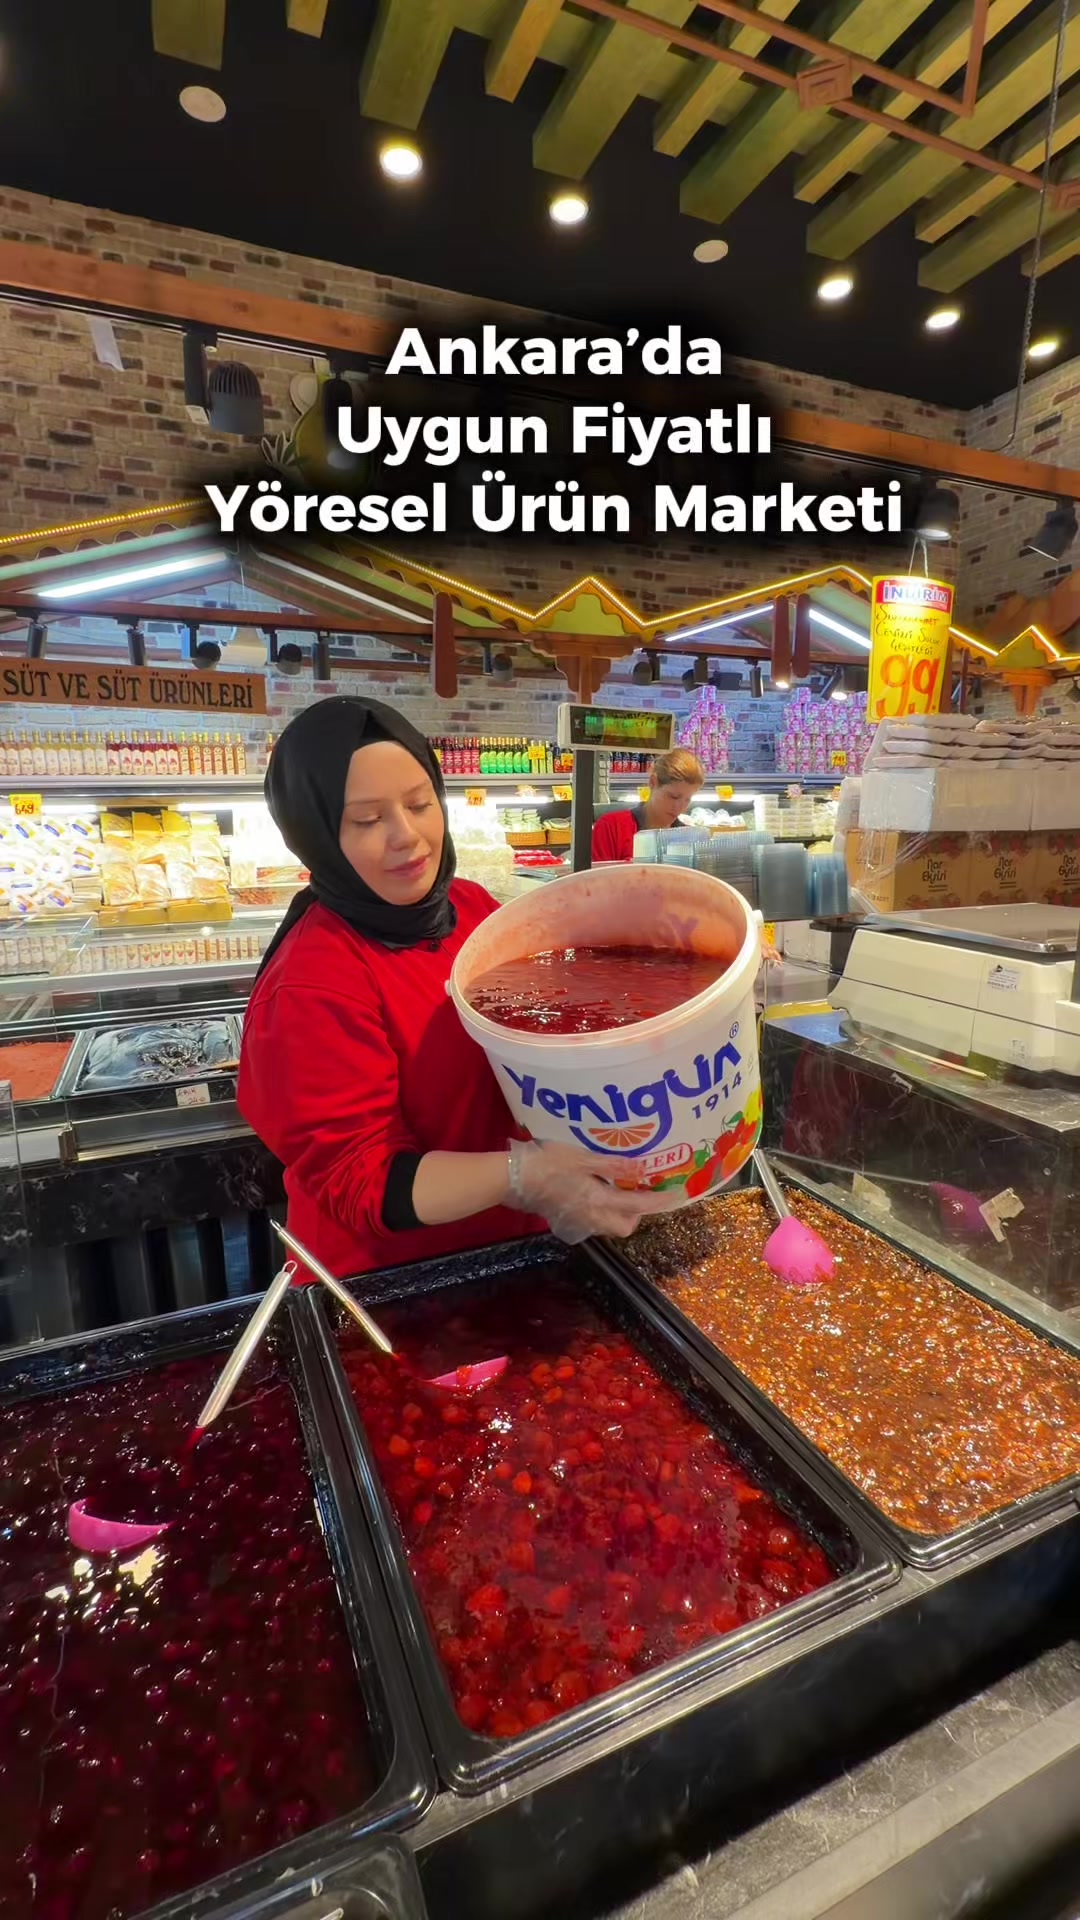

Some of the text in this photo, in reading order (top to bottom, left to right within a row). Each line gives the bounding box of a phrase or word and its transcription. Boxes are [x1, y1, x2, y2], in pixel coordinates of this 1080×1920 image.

[3, 663, 253, 708] SÜT VE SÜT ÜRÜNLERİ
[501, 1041, 742, 1157] Yenigün
[692, 1071, 742, 1119] 1914
